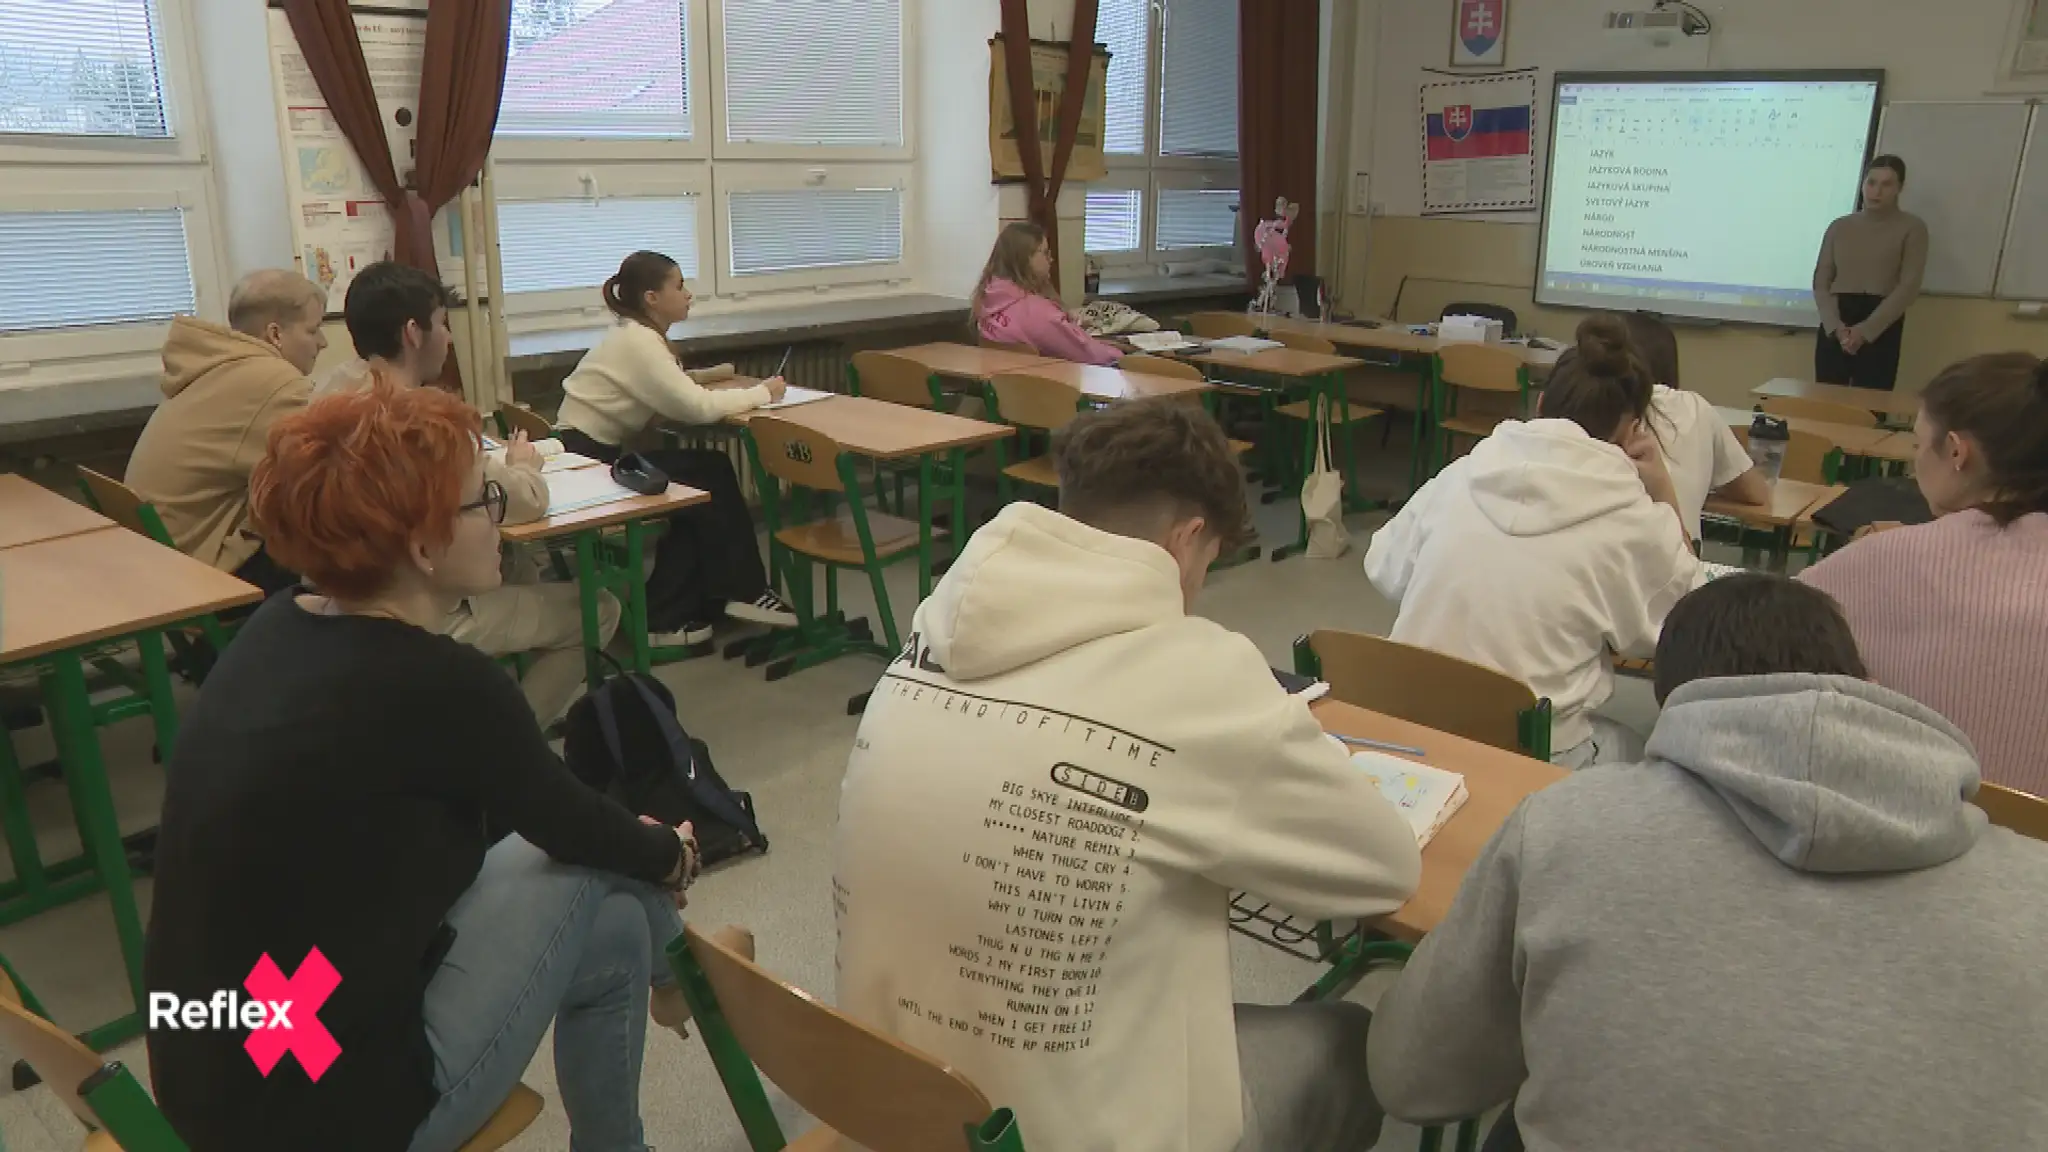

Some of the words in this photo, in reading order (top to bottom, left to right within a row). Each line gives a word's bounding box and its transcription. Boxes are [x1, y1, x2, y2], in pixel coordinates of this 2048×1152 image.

[1632, 167, 1668, 176] RODINA
[892, 682, 924, 701] THE
[944, 695, 988, 718] END
[1016, 710, 1051, 729] OF
[1085, 727, 1162, 768] TIME
[1002, 780, 1024, 797] BIG
[1030, 788, 1059, 806] SKYE
[1061, 765, 1124, 800] SIDE
[988, 797, 1004, 811] MY
[1008, 803, 1062, 826] CLOSEST
[1067, 817, 1126, 840] ROADDOGZ
[1032, 829, 1077, 848] NATURE
[1084, 840, 1121, 857] REMIX
[962, 851, 971, 864] U
[975, 854, 1010, 874] DON'T
[1016, 866, 1046, 883] HAVE
[1055, 874, 1070, 887] TO
[1076, 878, 1113, 893] WORRY
[1013, 845, 1044, 863] WHEN
[1051, 853, 1089, 871] THUGZ
[1094, 861, 1117, 875] CRY
[993, 880, 1021, 897] THIS
[1027, 889, 1066, 906] AIN'T
[1073, 896, 1111, 912] LIVIN
[988, 900, 1011, 914] WHY
[1017, 906, 1026, 918] U
[1033, 908, 1063, 925] TURN
[1069, 915, 1085, 928] ON
[1090, 916, 1104, 929] ME
[977, 934, 1004, 951] THUG
[1010, 943, 1018, 954] N
[1025, 947, 1033, 957] U
[1080, 951, 1093, 963] ME
[1071, 933, 1099, 947] LEFT
[949, 944, 980, 964] WORDS
[986, 955, 993, 967] 2
[998, 959, 1014, 973] MY
[1019, 963, 1056, 981] FIRST
[1061, 968, 1088, 981] BORN
[959, 966, 1024, 994] EVERYTHING
[1032, 984, 1060, 998] THEY
[977, 1010, 1005, 1028] WHEN
[1023, 1022, 1046, 1034] GET
[1052, 1021, 1078, 1034] FREE
[1006, 999, 1049, 1016] RUNNIN
[1054, 1005, 1069, 1017] ON
[898, 996, 922, 1017] UNTIL
[928, 1010, 943, 1026] THE
[949, 1018, 969, 1033] END
[972, 1025, 984, 1038] OF
[990, 1032, 1016, 1050] TIME
[1044, 1040, 1077, 1053] REMIX
